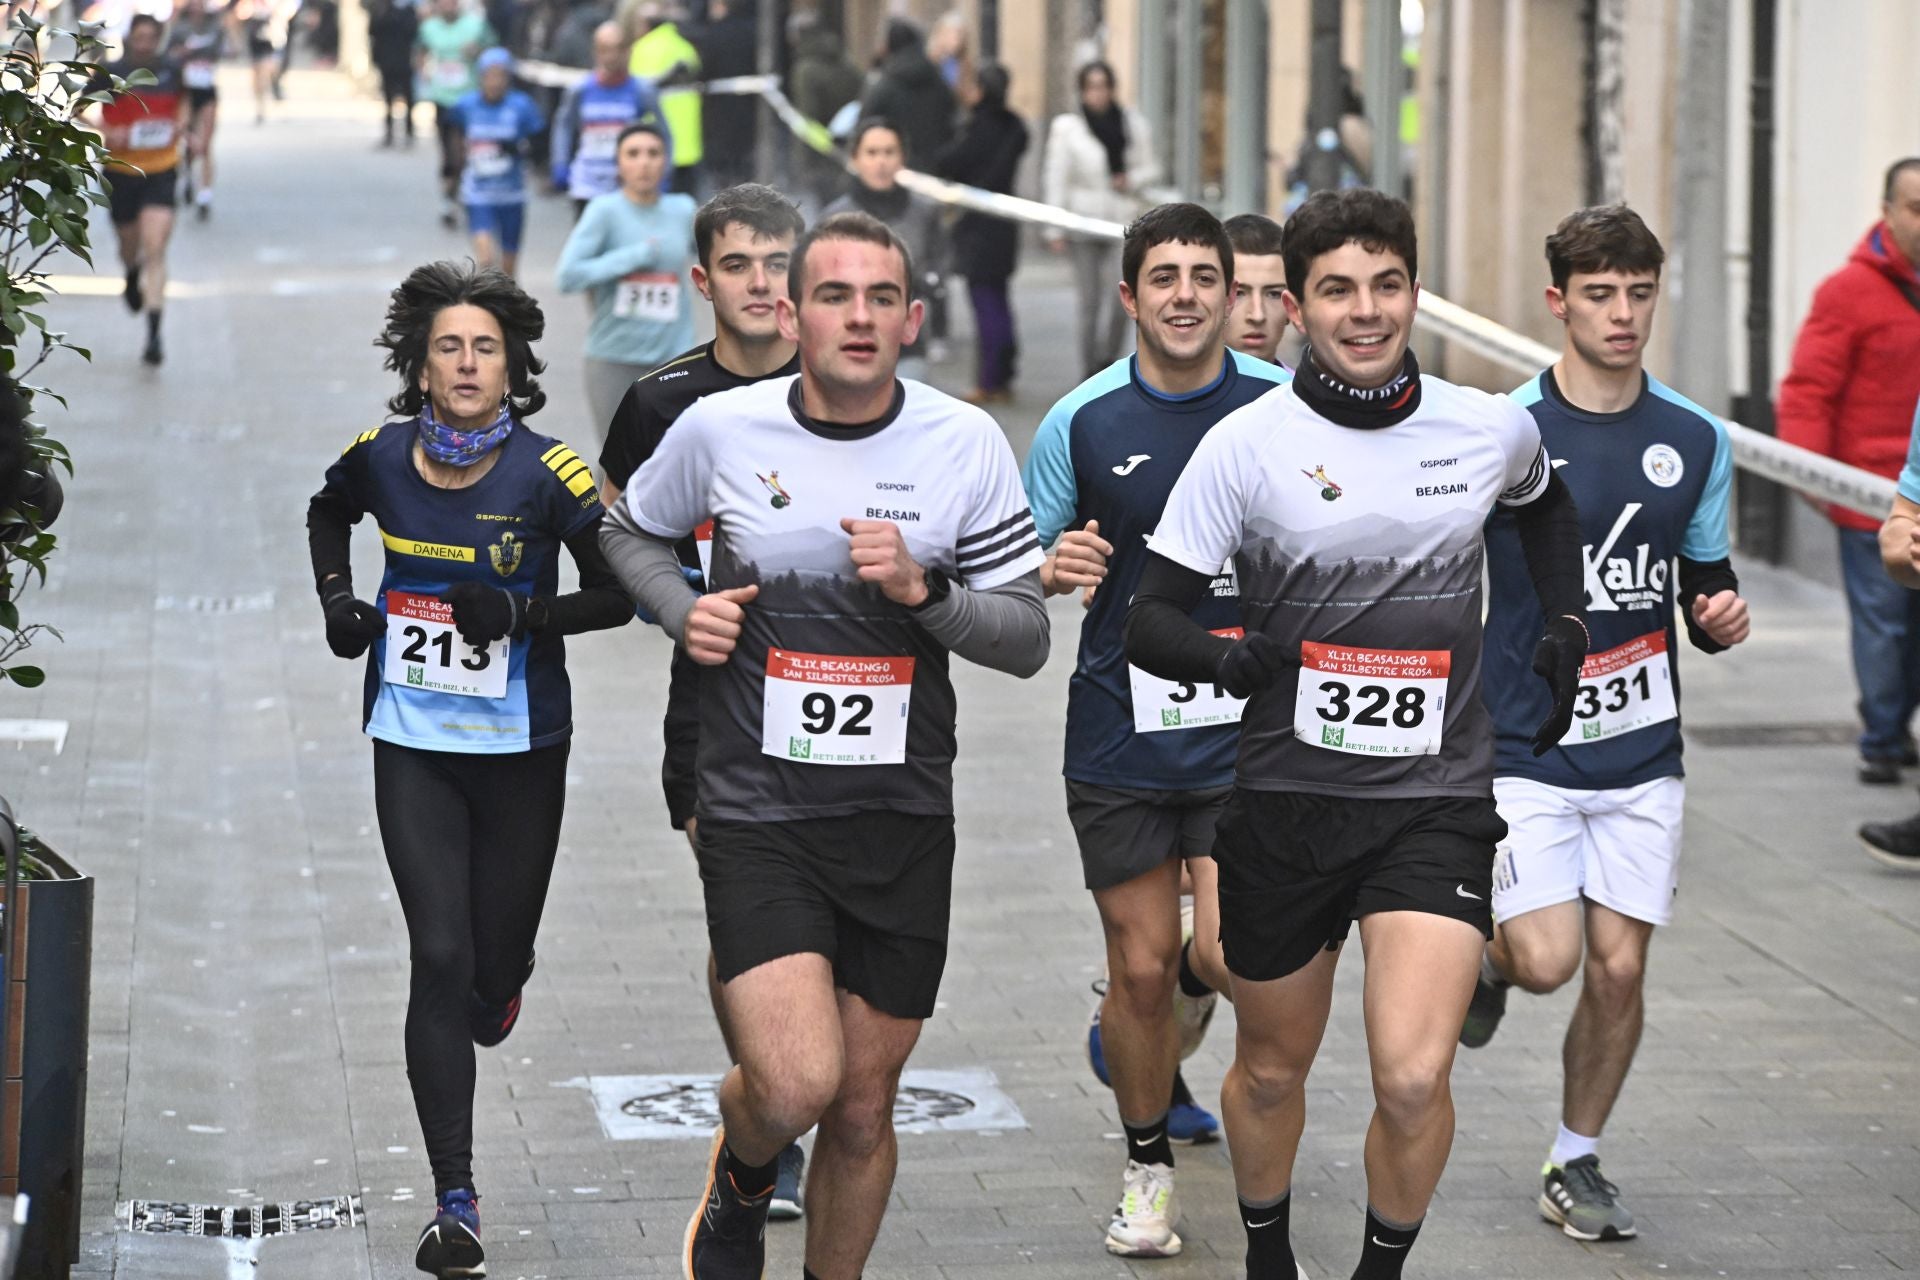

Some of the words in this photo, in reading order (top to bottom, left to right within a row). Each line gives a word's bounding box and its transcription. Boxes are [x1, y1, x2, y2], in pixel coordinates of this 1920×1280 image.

[1420, 457, 1459, 469] GSPORT
[875, 482, 915, 493] GSPORT
[1415, 482, 1468, 497] BEASAIN
[866, 507, 921, 522] BEASAIN
[413, 543, 465, 560] DANENA
[401, 606, 417, 616] SAN
[418, 609, 455, 622] SILBEST
[401, 625, 491, 671] 213
[783, 668, 802, 679] SAN
[805, 671, 862, 684] SILBESTRE
[866, 674, 896, 684] KROSA
[1318, 660, 1338, 671] SAN
[1341, 663, 1398, 676] SILBESTRE
[1402, 667, 1433, 677] KROSA
[1573, 665, 1651, 720] 331
[1315, 680, 1426, 729] 328
[801, 691, 874, 736] 92
[1345, 742, 1390, 754] BETI-BIZI,
